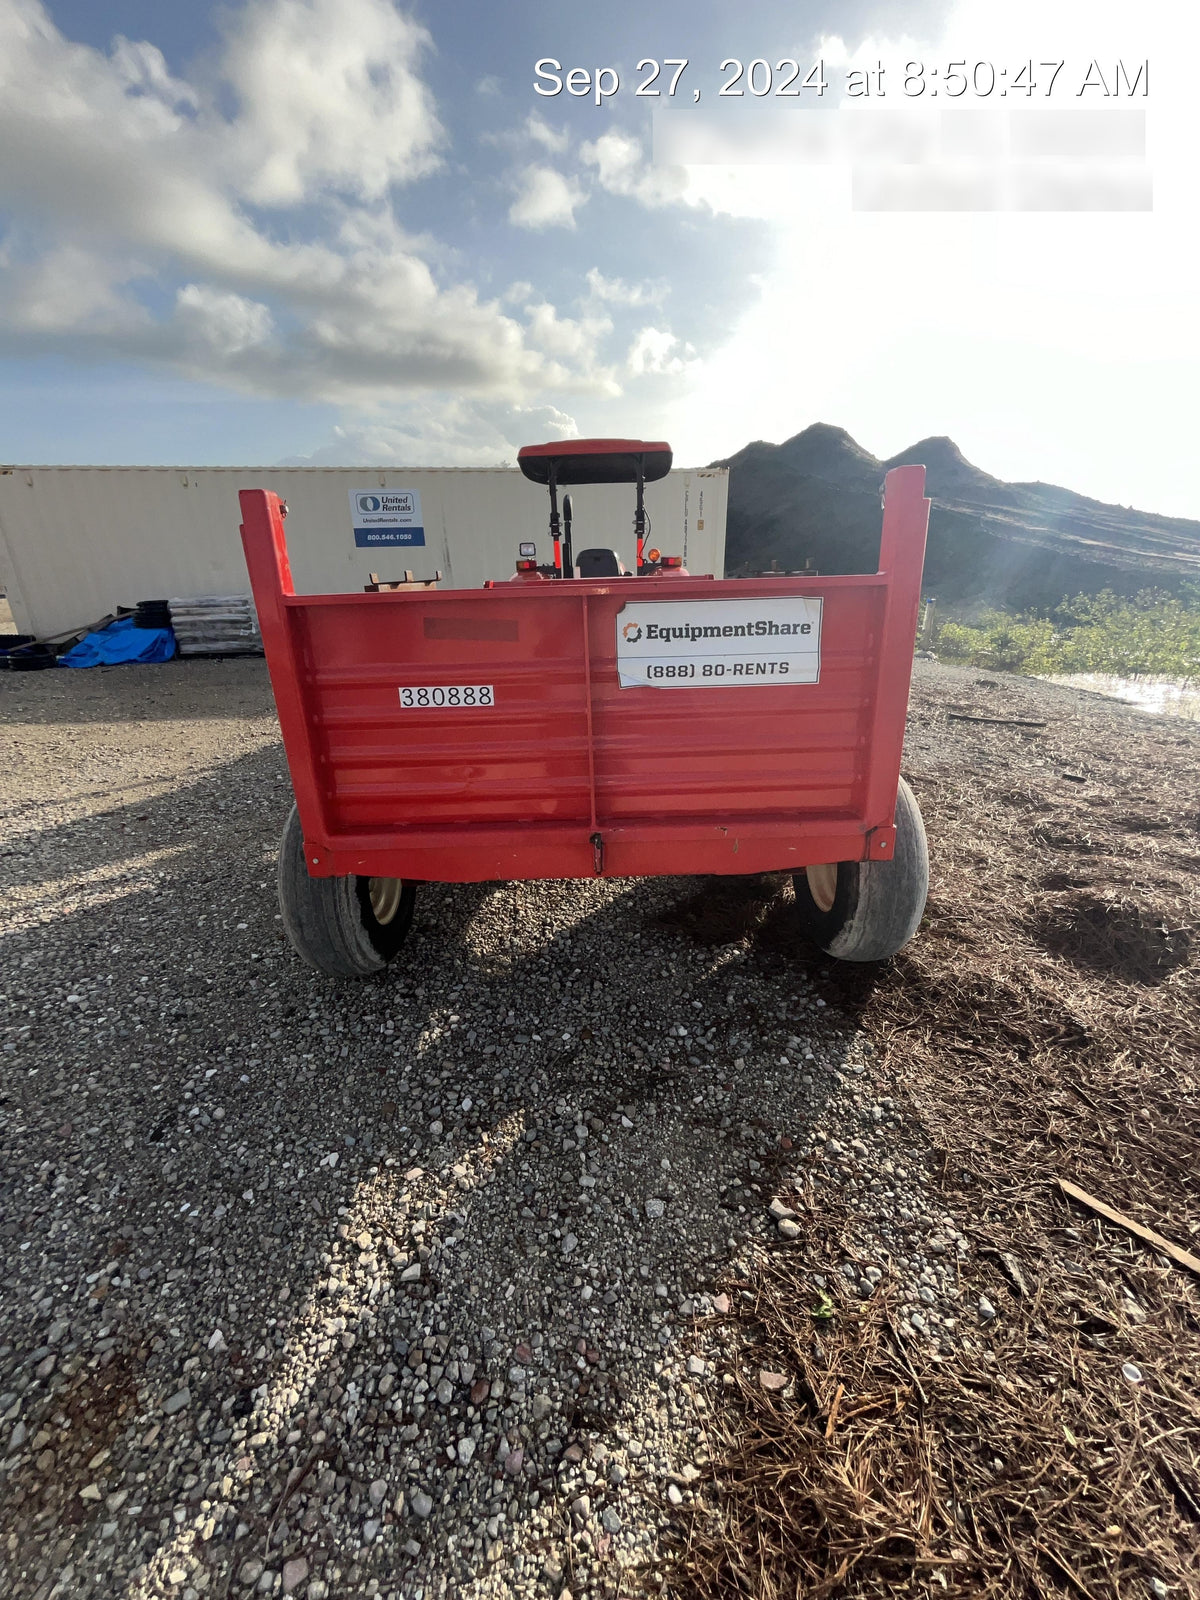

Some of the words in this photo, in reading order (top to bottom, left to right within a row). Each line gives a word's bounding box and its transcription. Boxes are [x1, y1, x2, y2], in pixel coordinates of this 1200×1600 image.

[381, 496, 408, 504] United
[382, 504, 411, 512] Rentals
[646, 620, 811, 642] EquipmentShare
[646, 664, 695, 679] (888)
[702, 662, 790, 677] 80-RENTS
[401, 687, 492, 706] 380888
